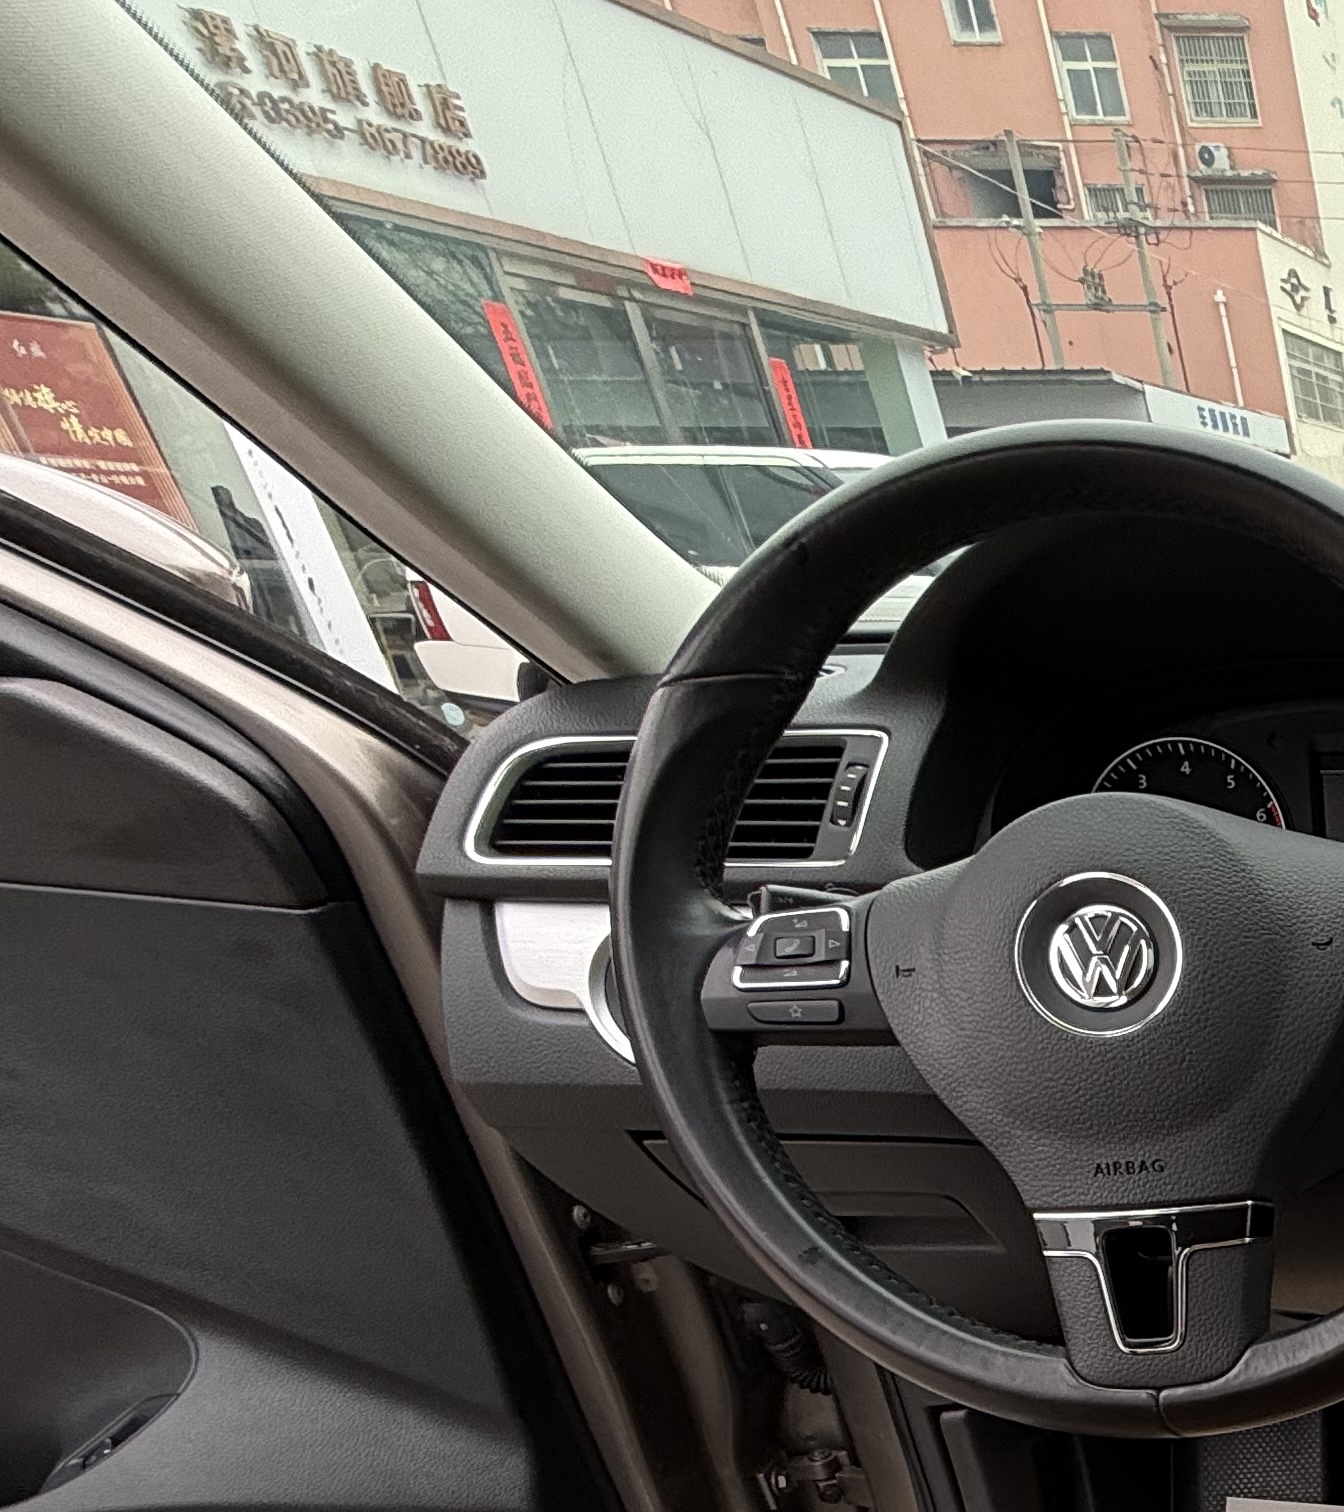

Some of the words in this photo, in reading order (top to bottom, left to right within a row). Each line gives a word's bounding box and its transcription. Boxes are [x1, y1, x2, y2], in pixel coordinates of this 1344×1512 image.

[180, 5, 473, 138] 漯河旗舰店
[1180, 760, 1192, 775] 4
[1138, 774, 1148, 789] 3
[1226, 775, 1236, 789] 5
[1256, 808, 1267, 822] 6
[1093, 1158, 1166, 1178] AIRBAG
